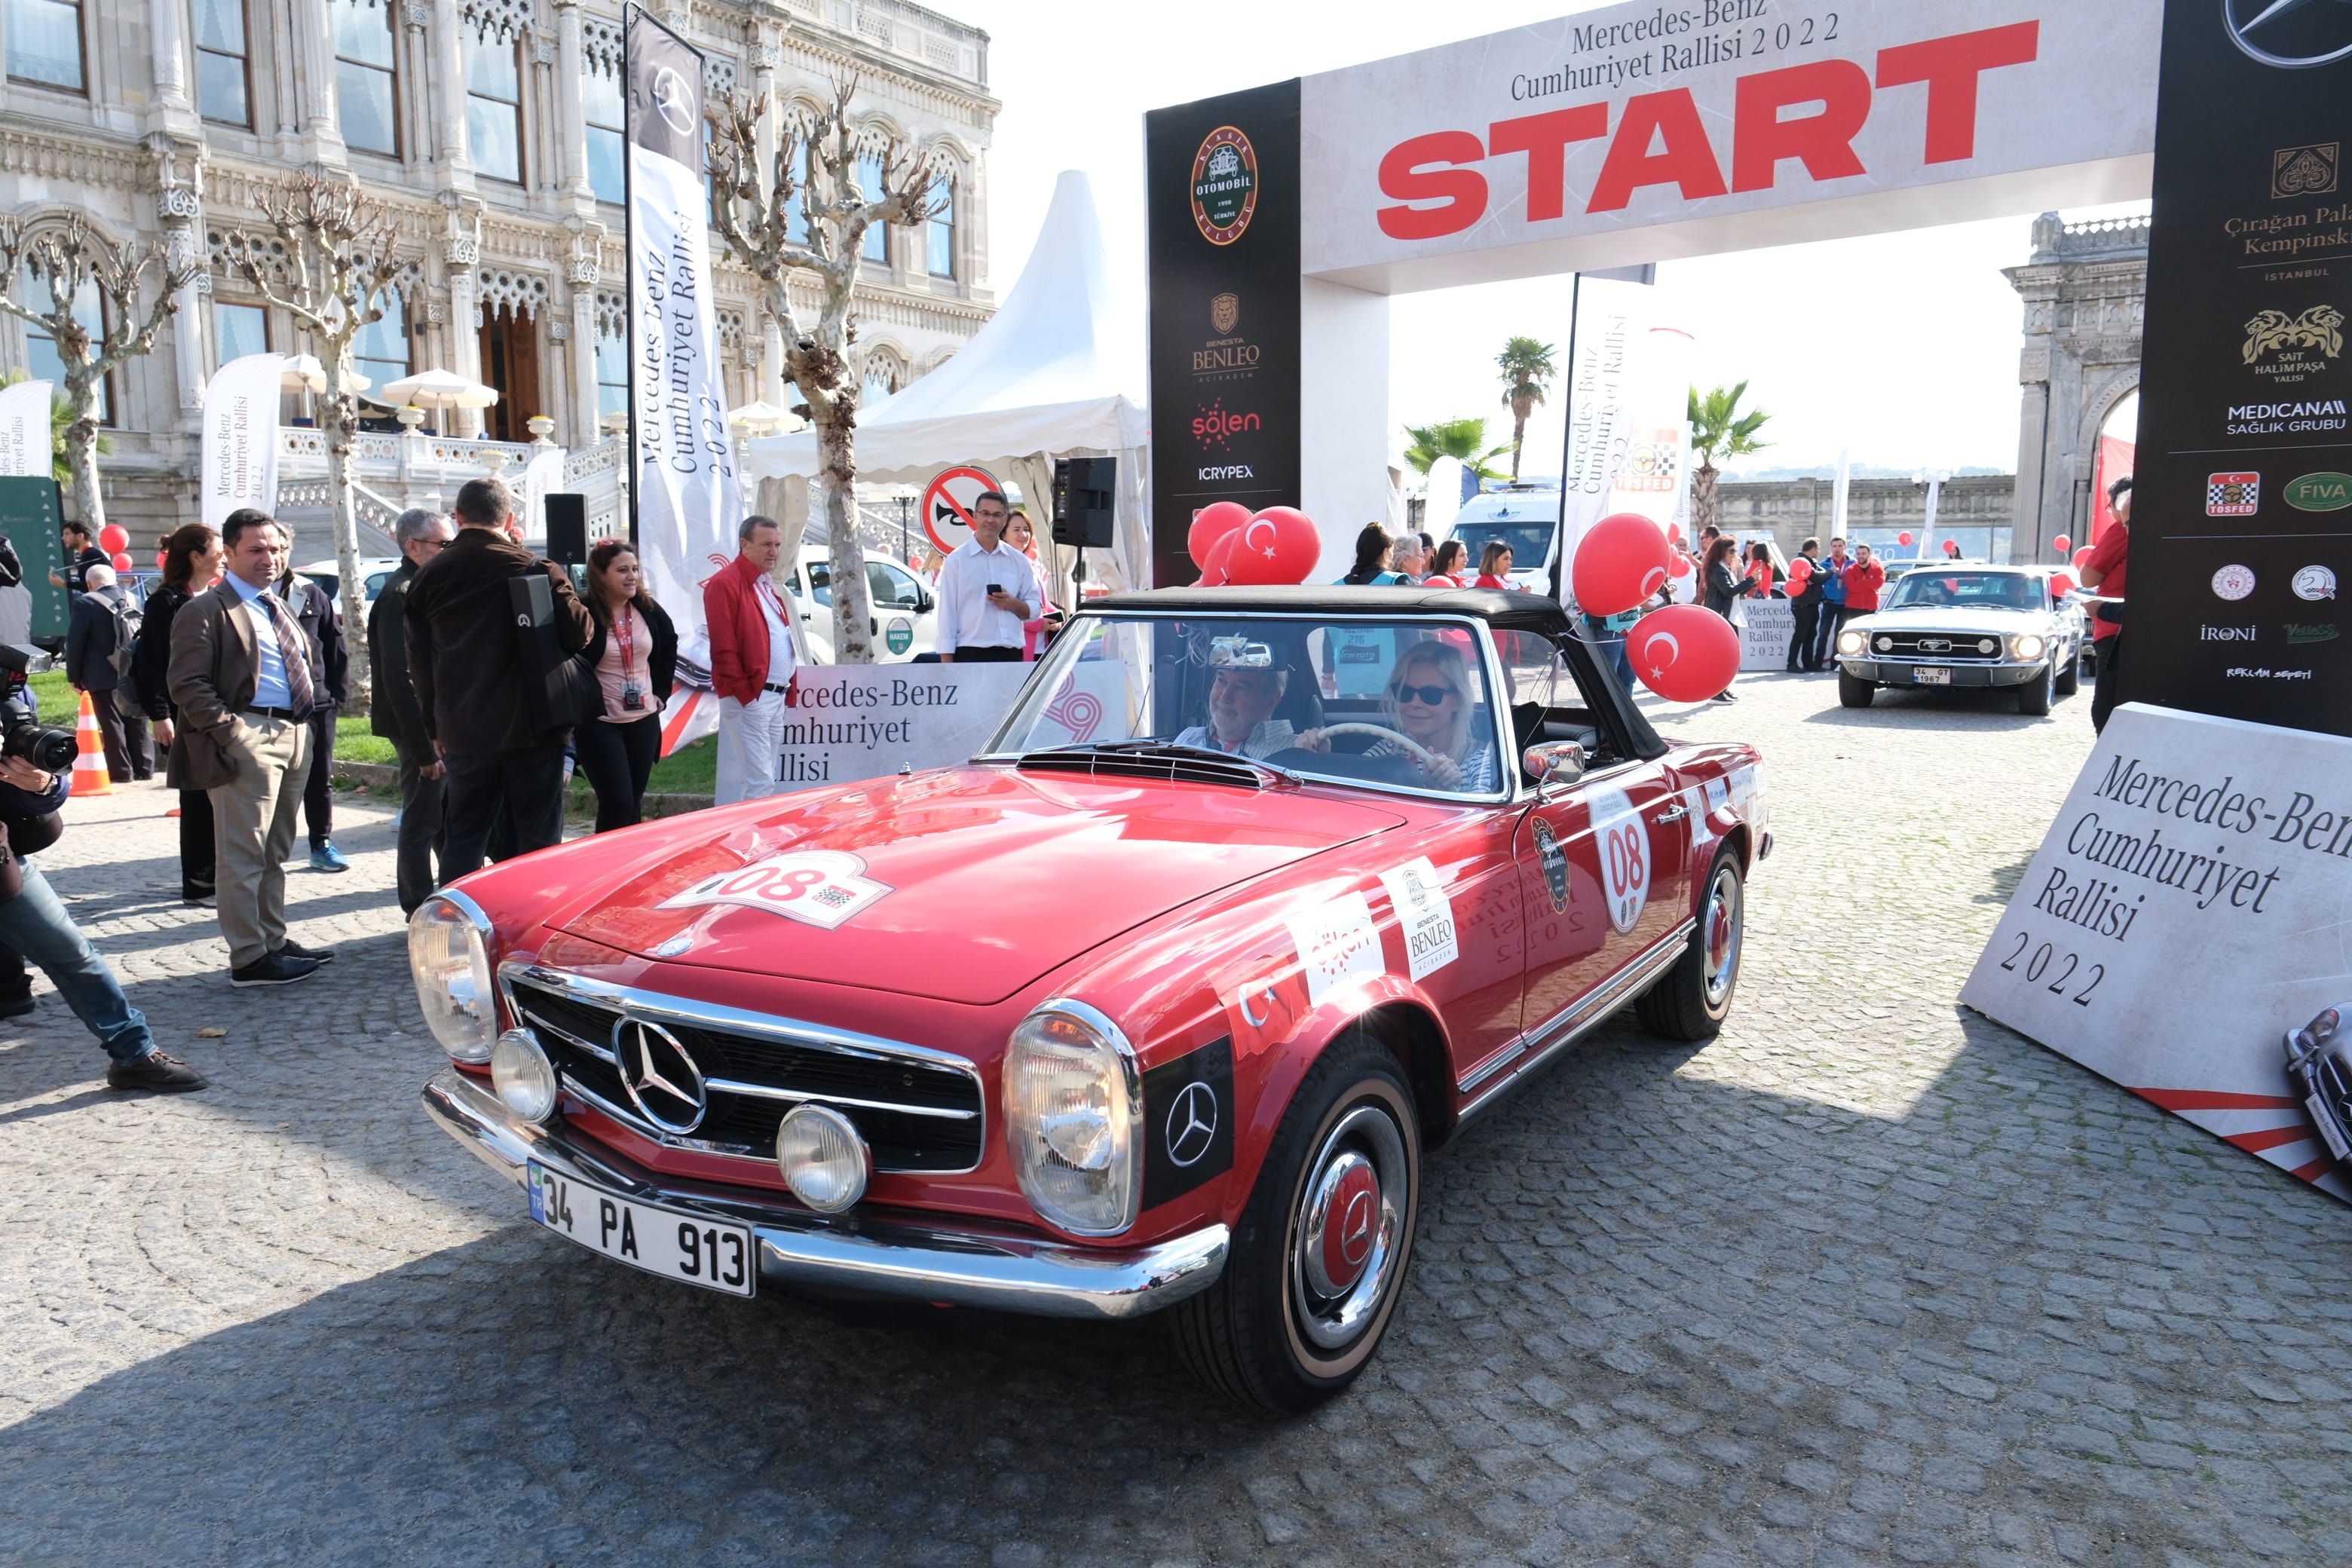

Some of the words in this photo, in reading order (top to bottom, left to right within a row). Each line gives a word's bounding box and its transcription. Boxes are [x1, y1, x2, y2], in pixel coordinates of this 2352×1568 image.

[1572, 0, 1767, 54] Mercedes-Benz
[1511, 51, 1653, 100] Cumhuriyet
[1661, 29, 1742, 72] Rallisi
[1751, 13, 1839, 56] 2022
[1377, 18, 2040, 240] START
[2225, 214, 2308, 237] Çırağan
[672, 210, 696, 302] Rallisi
[642, 250, 666, 464] Mercedes-Benz
[1206, 338, 1244, 348] BENESTA
[2296, 362, 2326, 372] PAŞA
[234, 396, 247, 430] Rallisi
[666, 309, 697, 473] Cumhuriyet
[1584, 384, 1619, 495] Cumhuriyet
[1603, 315, 1626, 374] Rallisi
[700, 396, 731, 478] 2022
[1568, 347, 1598, 492] Mercedes-Benz
[2227, 421, 2284, 434] SAĞLIK
[2289, 419, 2346, 432] GRUBU
[217, 413, 231, 497] Mercedes-Benz
[234, 435, 250, 498] Cumhuriyet
[1199, 465, 1254, 480] ICRYPEX
[251, 466, 263, 500] 2022
[2210, 505, 2253, 514] TOSFED
[2300, 485, 2346, 499] FIVA
[1749, 631, 1783, 642] Rallisi
[1750, 646, 1784, 657] 2022
[782, 715, 911, 750] mhuriyet
[777, 752, 830, 782] llisi
[2093, 755, 2352, 859] Mercedes-Ben
[717, 867, 826, 901] 08
[1609, 824, 1643, 897] 08
[2068, 812, 2280, 913] Cumhuriyet
[1417, 913, 1440, 929] BENESTA
[2033, 867, 2145, 942] Rallisi
[2001, 932, 2105, 1006] 2022
[531, 1193, 543, 1211] TR
[543, 1174, 573, 1233] 34
[600, 1198, 639, 1260] PA
[678, 1222, 745, 1287] 913
